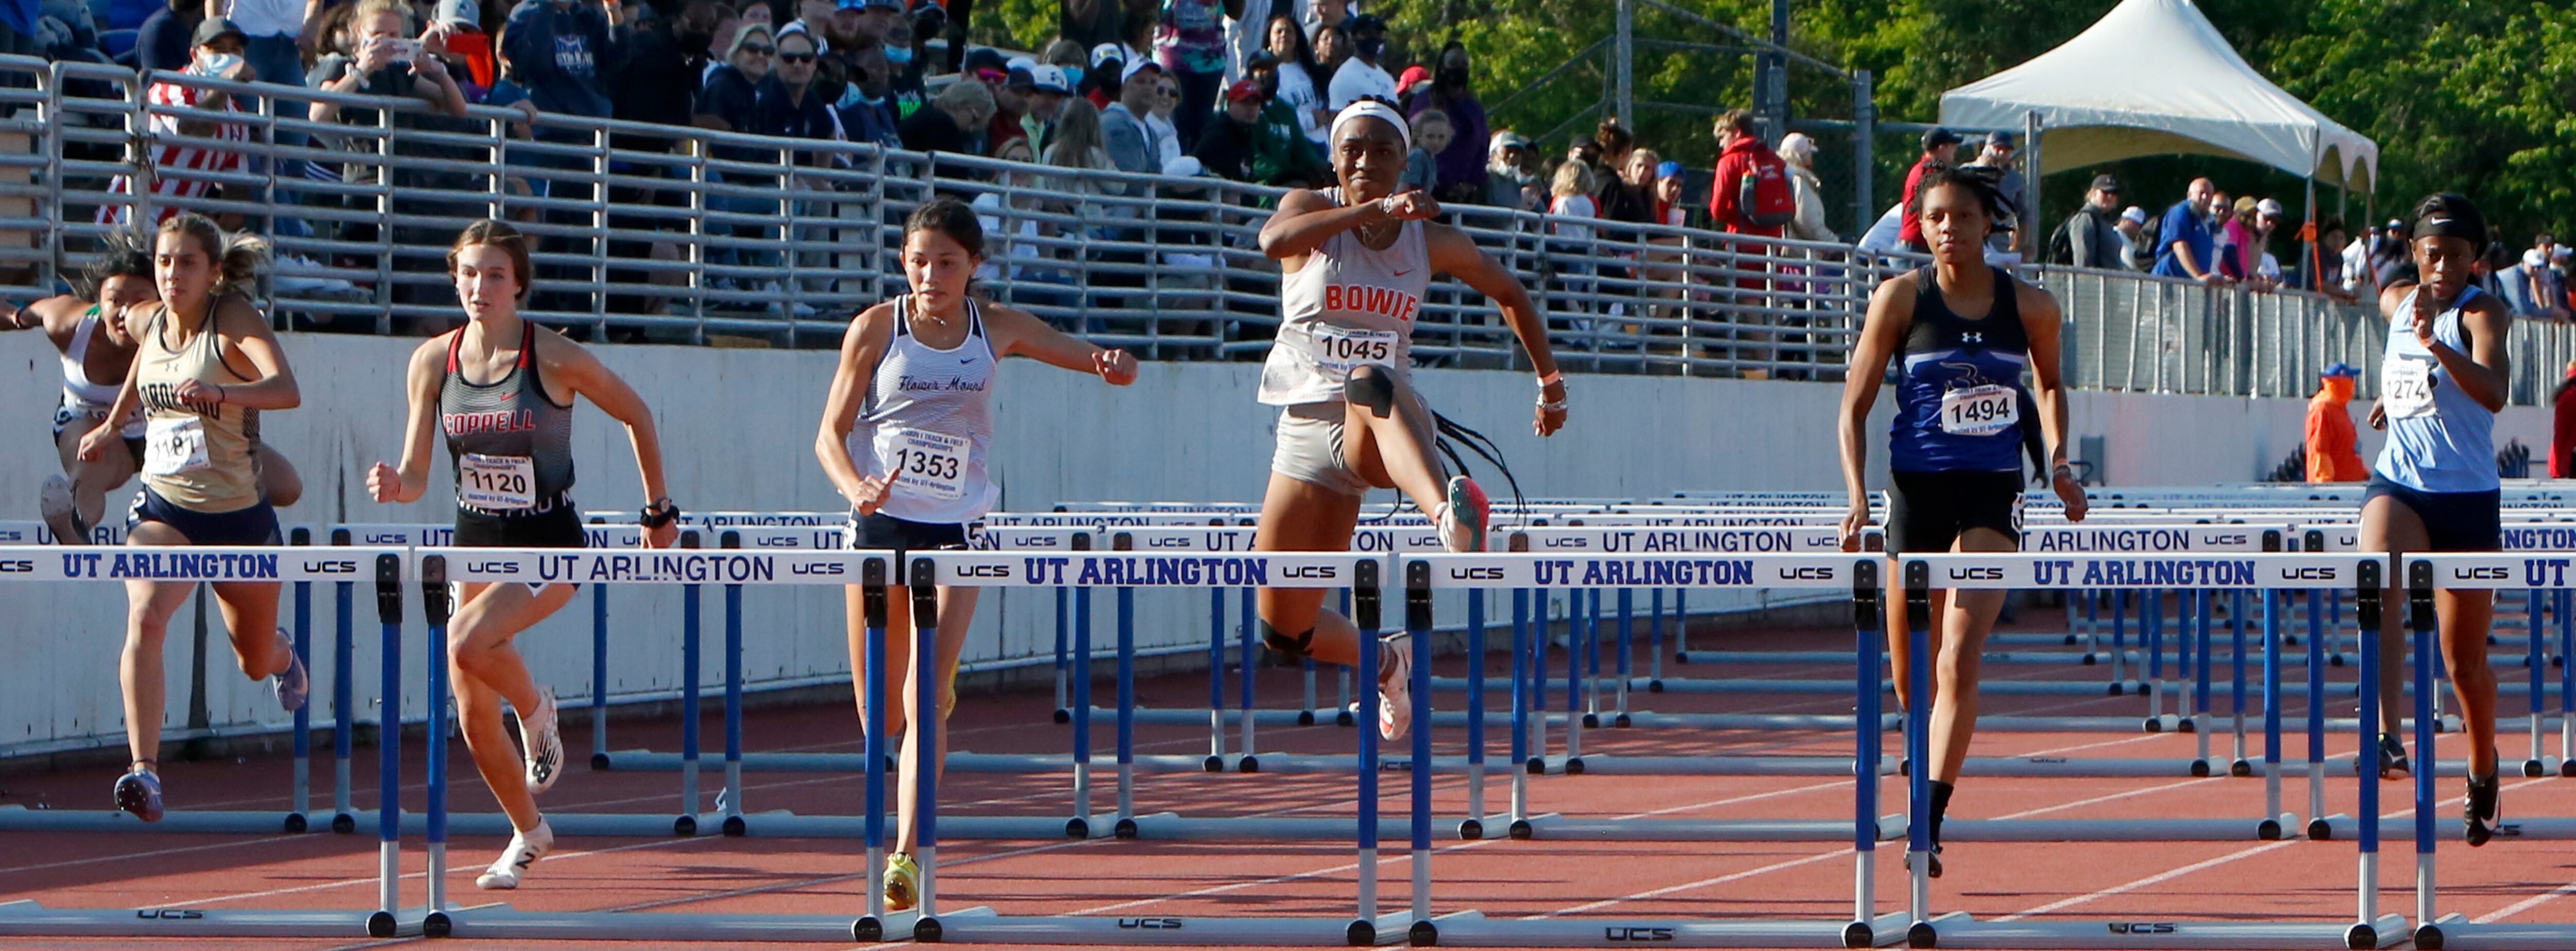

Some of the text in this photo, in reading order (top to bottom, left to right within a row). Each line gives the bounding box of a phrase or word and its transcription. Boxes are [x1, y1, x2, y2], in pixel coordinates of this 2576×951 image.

[1325, 284, 1416, 322] BOWIE
[1321, 335, 1388, 360] 1045
[897, 375, 987, 393] Flower Mound
[2387, 380, 2426, 400] 1274
[1951, 397, 2010, 424] 1494
[443, 409, 535, 436] COPPELL
[896, 448, 958, 480] 1353
[470, 469, 526, 499] 1120
[366, 535, 406, 544] UCS
[757, 537, 798, 546] UCS
[1015, 536, 1057, 546] UCS
[1149, 537, 1190, 547] UCS
[1206, 532, 1239, 551] UT
[1546, 532, 1792, 552] UCS UT ARLINGTON
[2040, 531, 2189, 551] ARLINGTON
[2205, 535, 2247, 545] UCS
[62, 553, 101, 578] UT
[110, 553, 278, 578] ARLINGTON
[303, 561, 357, 573] UCS
[468, 555, 844, 581] UCS UT ARLINGTON UCS
[957, 557, 1336, 585] UCS UT ARLINGTON UCS
[1451, 560, 1833, 585] UCS UT ARLINGTON UCS
[1950, 561, 2336, 585] UCS UT ARLINGTON UCS
[2454, 559, 2570, 586] UCS UT
[138, 909, 204, 920] UCS
[1119, 918, 1182, 928] UCS
[1605, 927, 1675, 941] UCS
[2108, 922, 2177, 933] UCS
